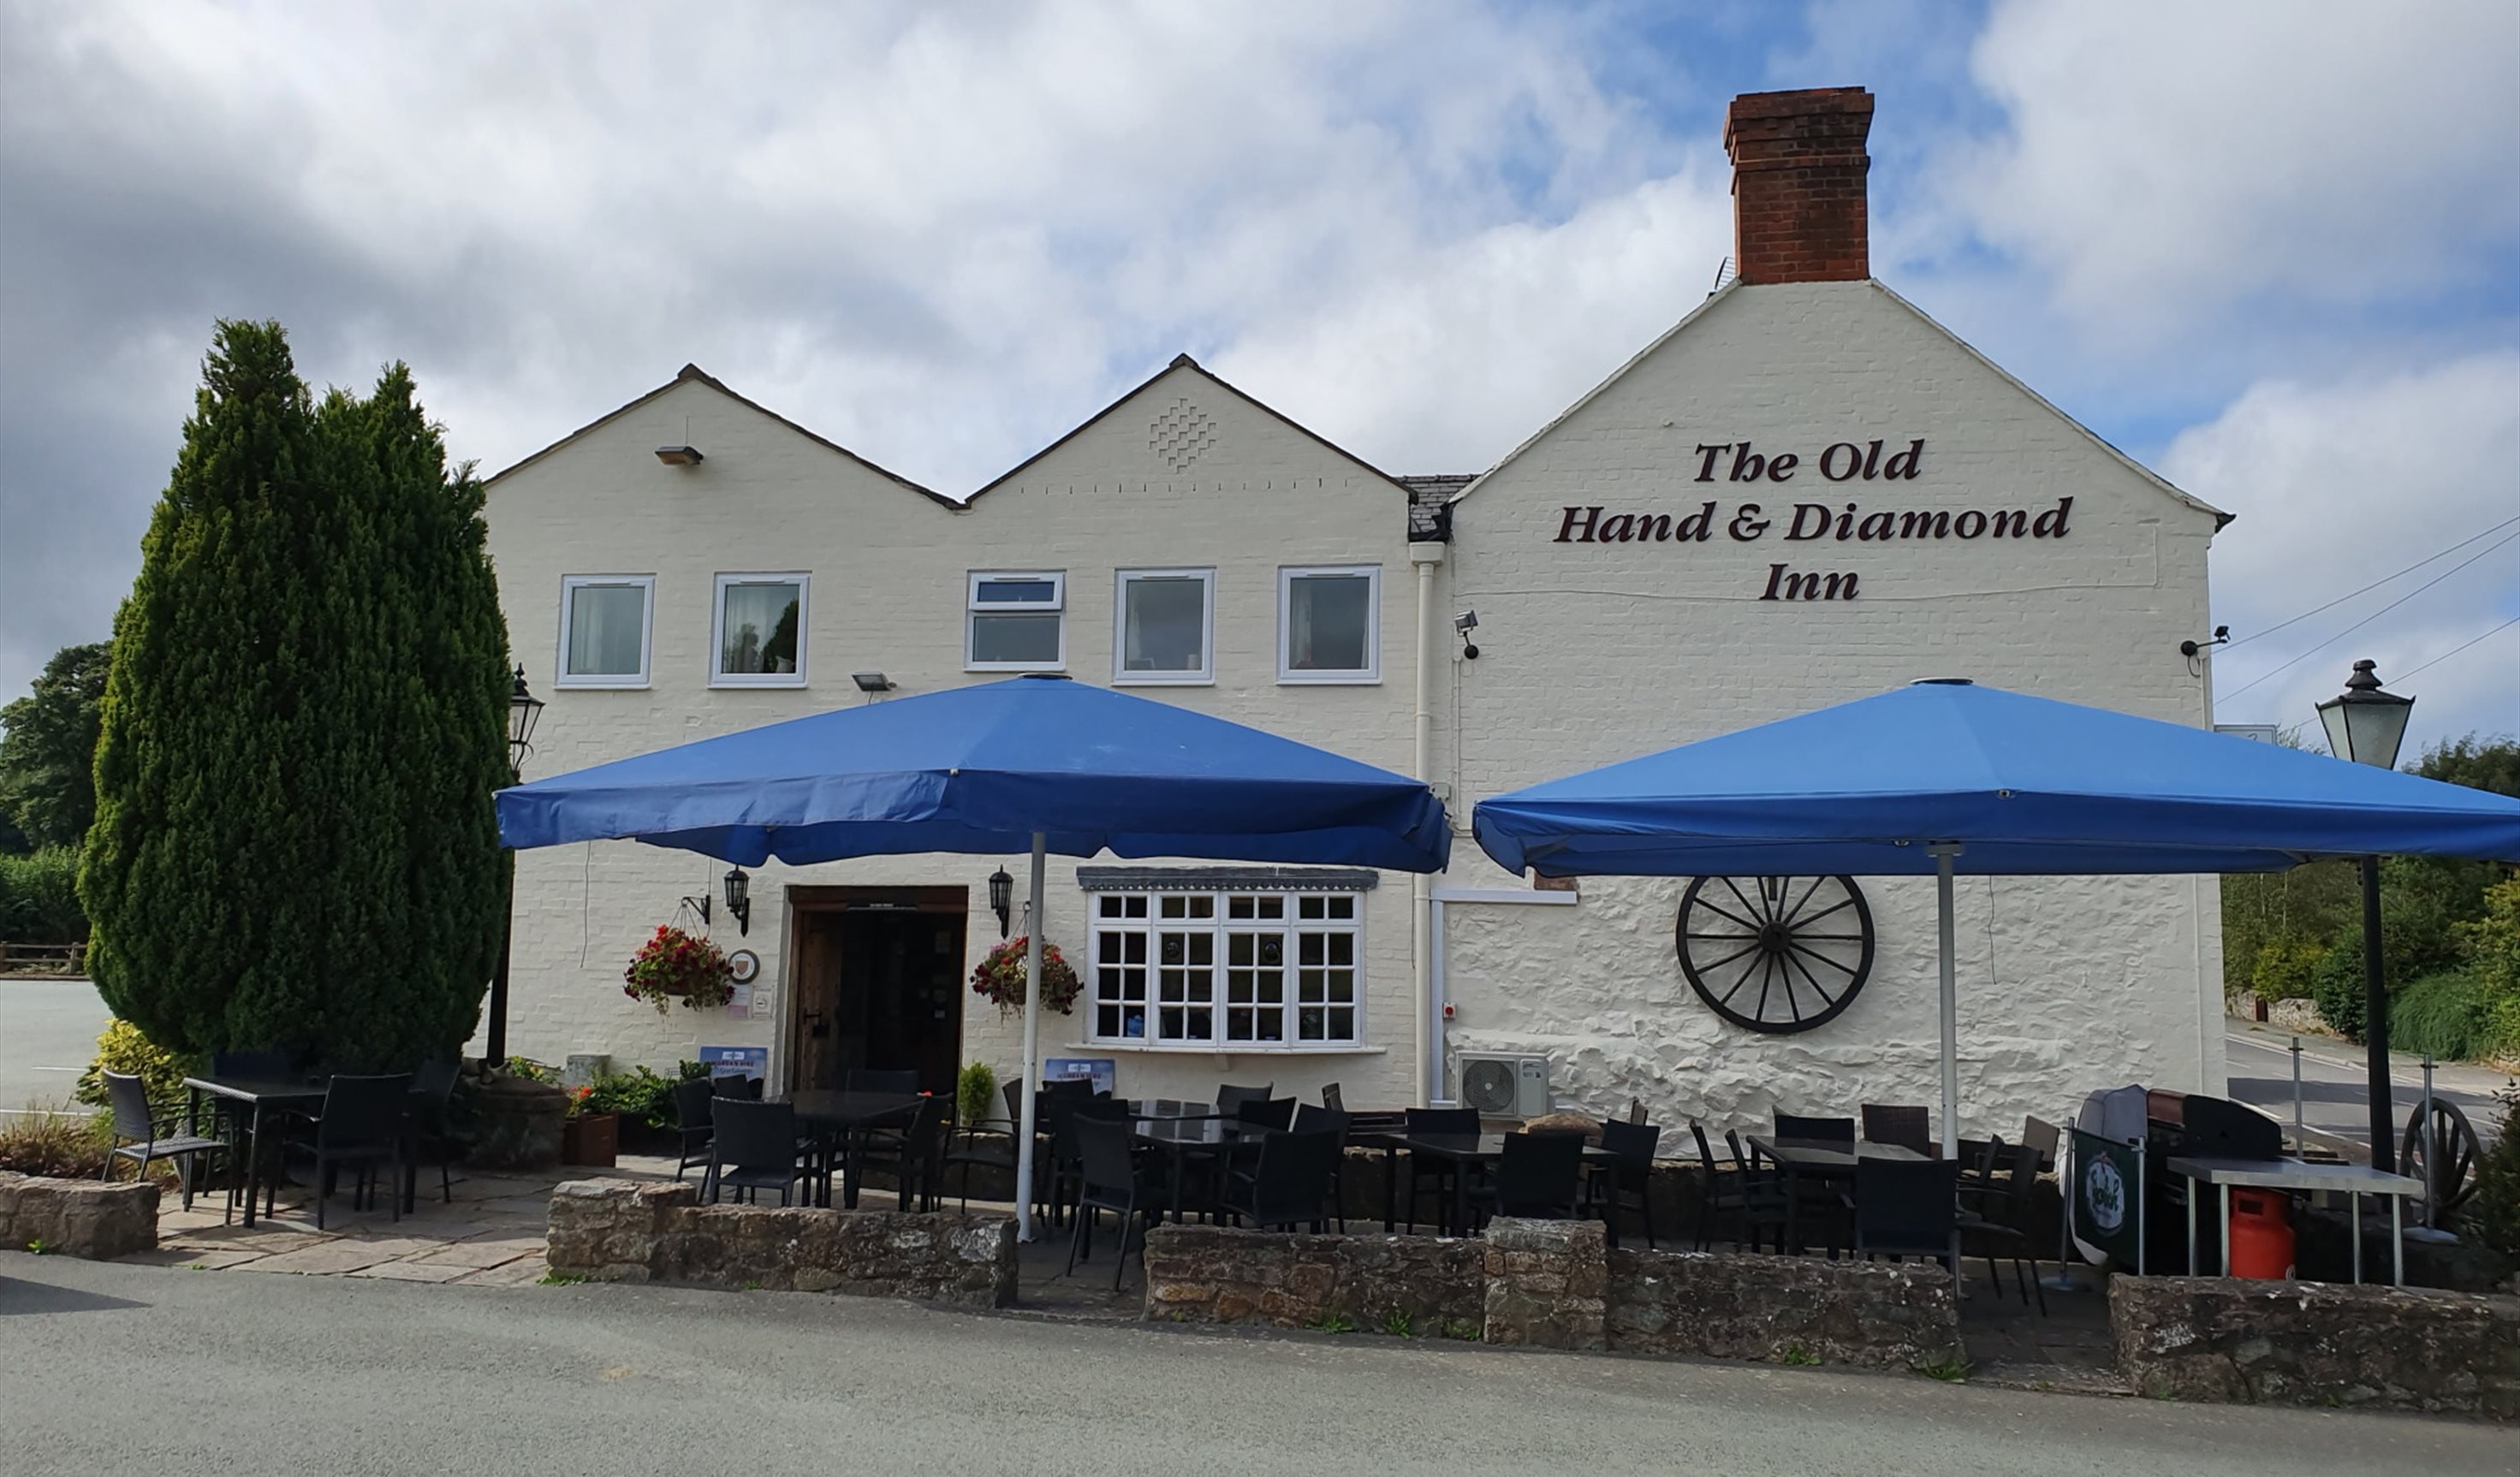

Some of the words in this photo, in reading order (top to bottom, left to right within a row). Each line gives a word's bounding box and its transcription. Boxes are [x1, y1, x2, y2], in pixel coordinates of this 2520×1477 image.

[1694, 442, 1798, 483] The
[1820, 438, 1925, 481] Old
[1553, 501, 1717, 543] Hand
[1727, 503, 1770, 542] &
[1783, 496, 2074, 542] Diamond
[1757, 563, 1859, 601] Inn
